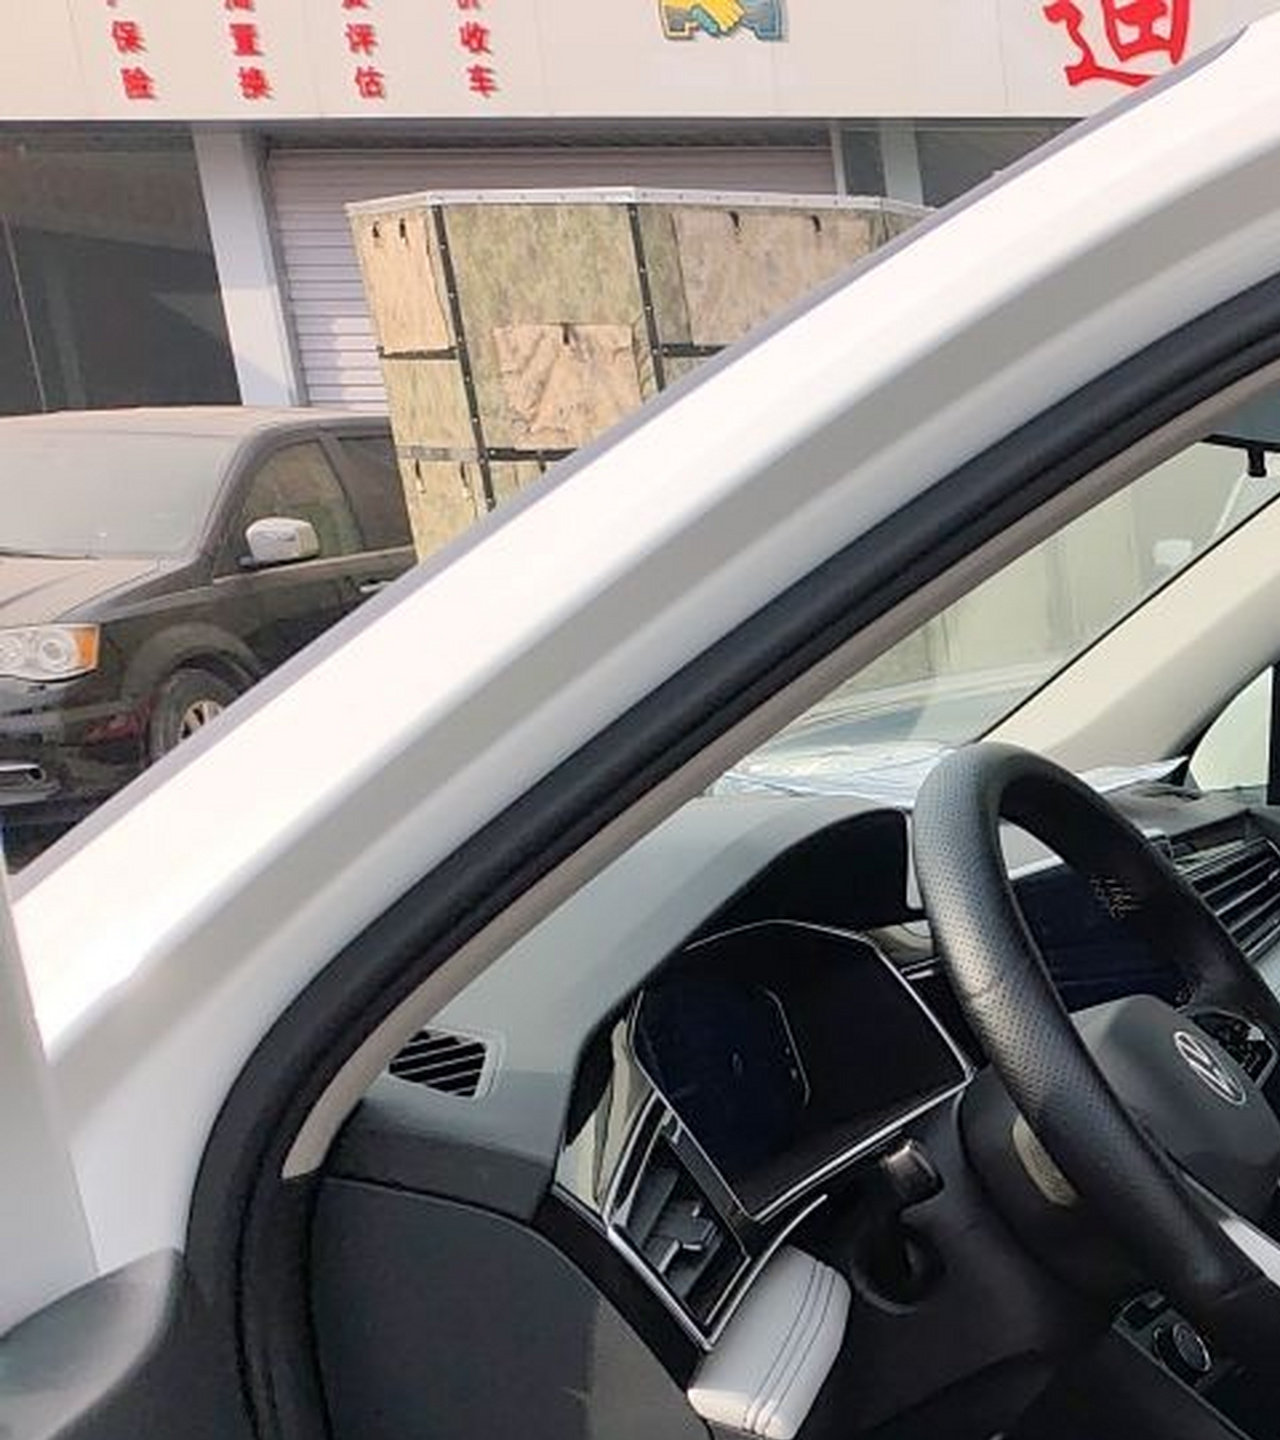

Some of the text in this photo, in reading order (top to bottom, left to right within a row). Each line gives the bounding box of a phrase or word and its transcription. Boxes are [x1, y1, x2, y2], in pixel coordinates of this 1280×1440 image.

[106, 0, 157, 99] 保险
[225, 0, 274, 99] 置换
[342, 0, 388, 98] 评估
[457, 0, 500, 98] 收车
